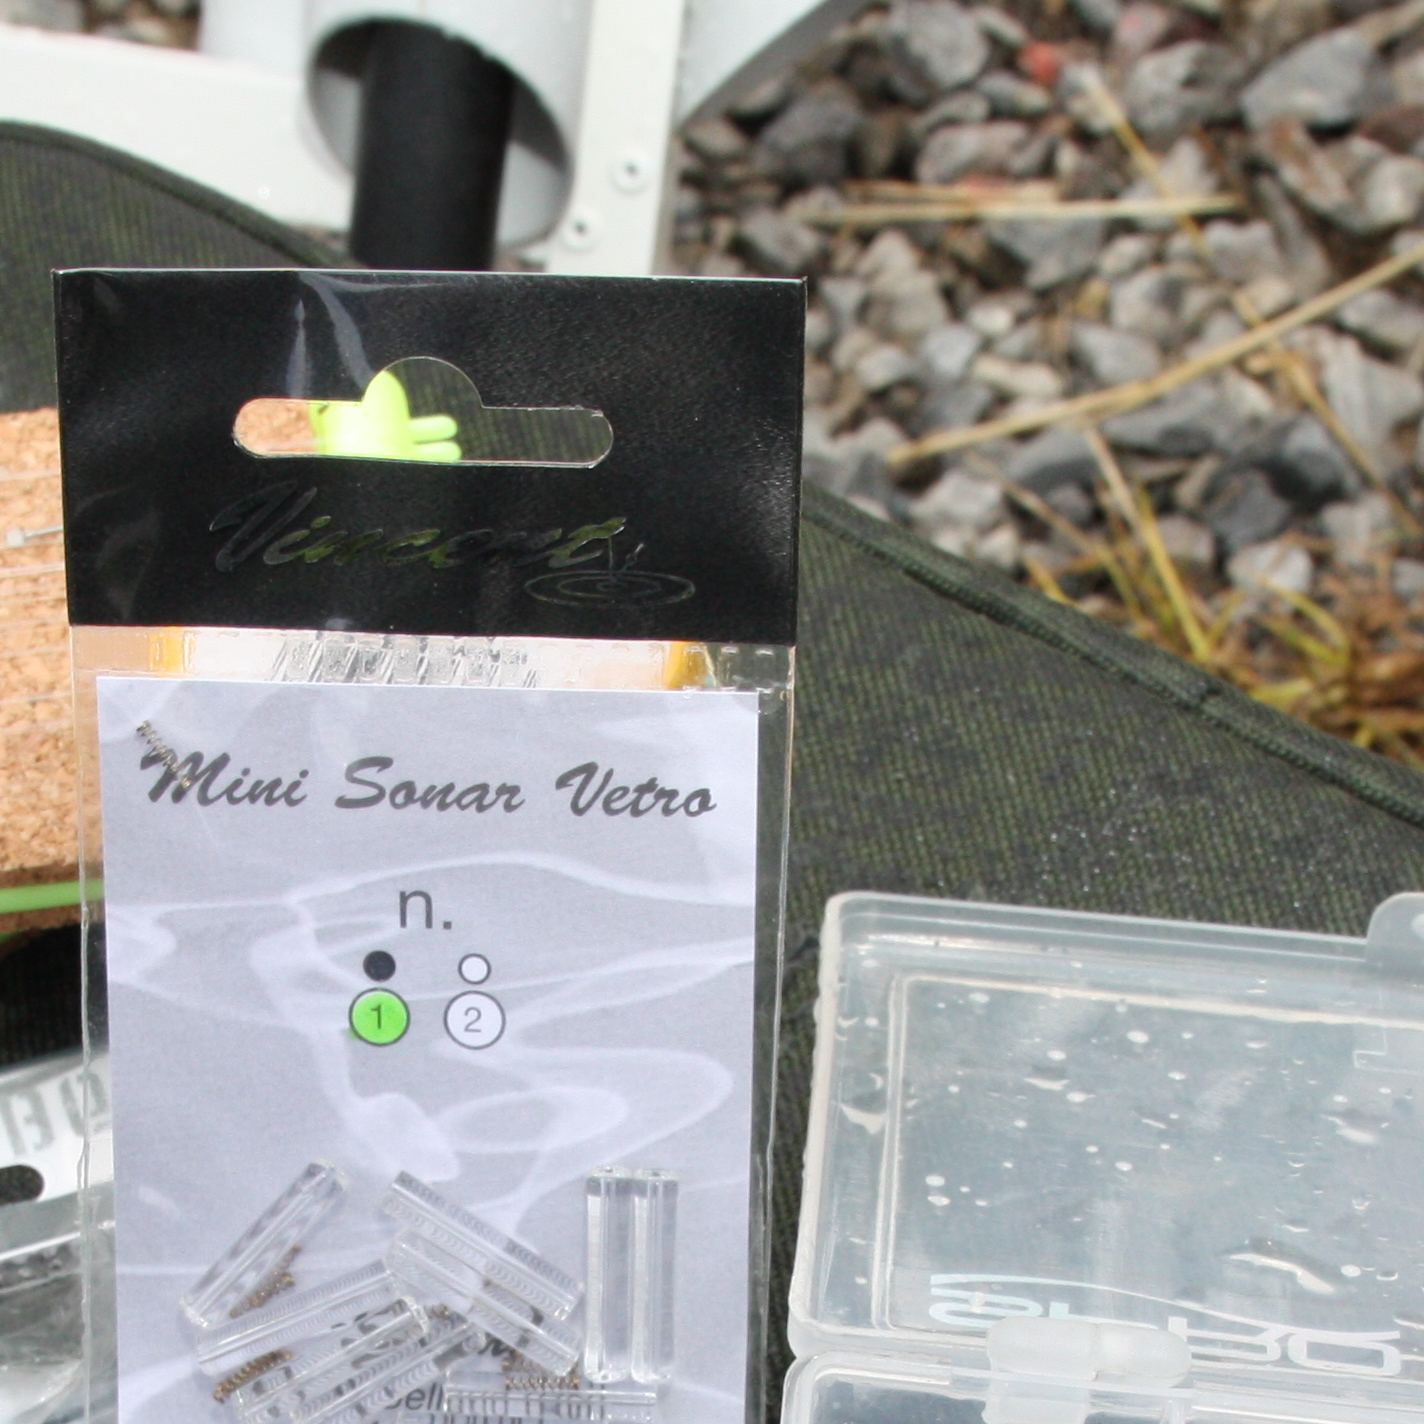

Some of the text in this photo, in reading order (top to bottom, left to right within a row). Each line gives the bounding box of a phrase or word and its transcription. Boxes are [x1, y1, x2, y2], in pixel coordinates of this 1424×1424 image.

[140, 748, 717, 817] Mini Sonar Vetro
[399, 889, 453, 929] n.
[372, 1005, 482, 1032] 1 2
